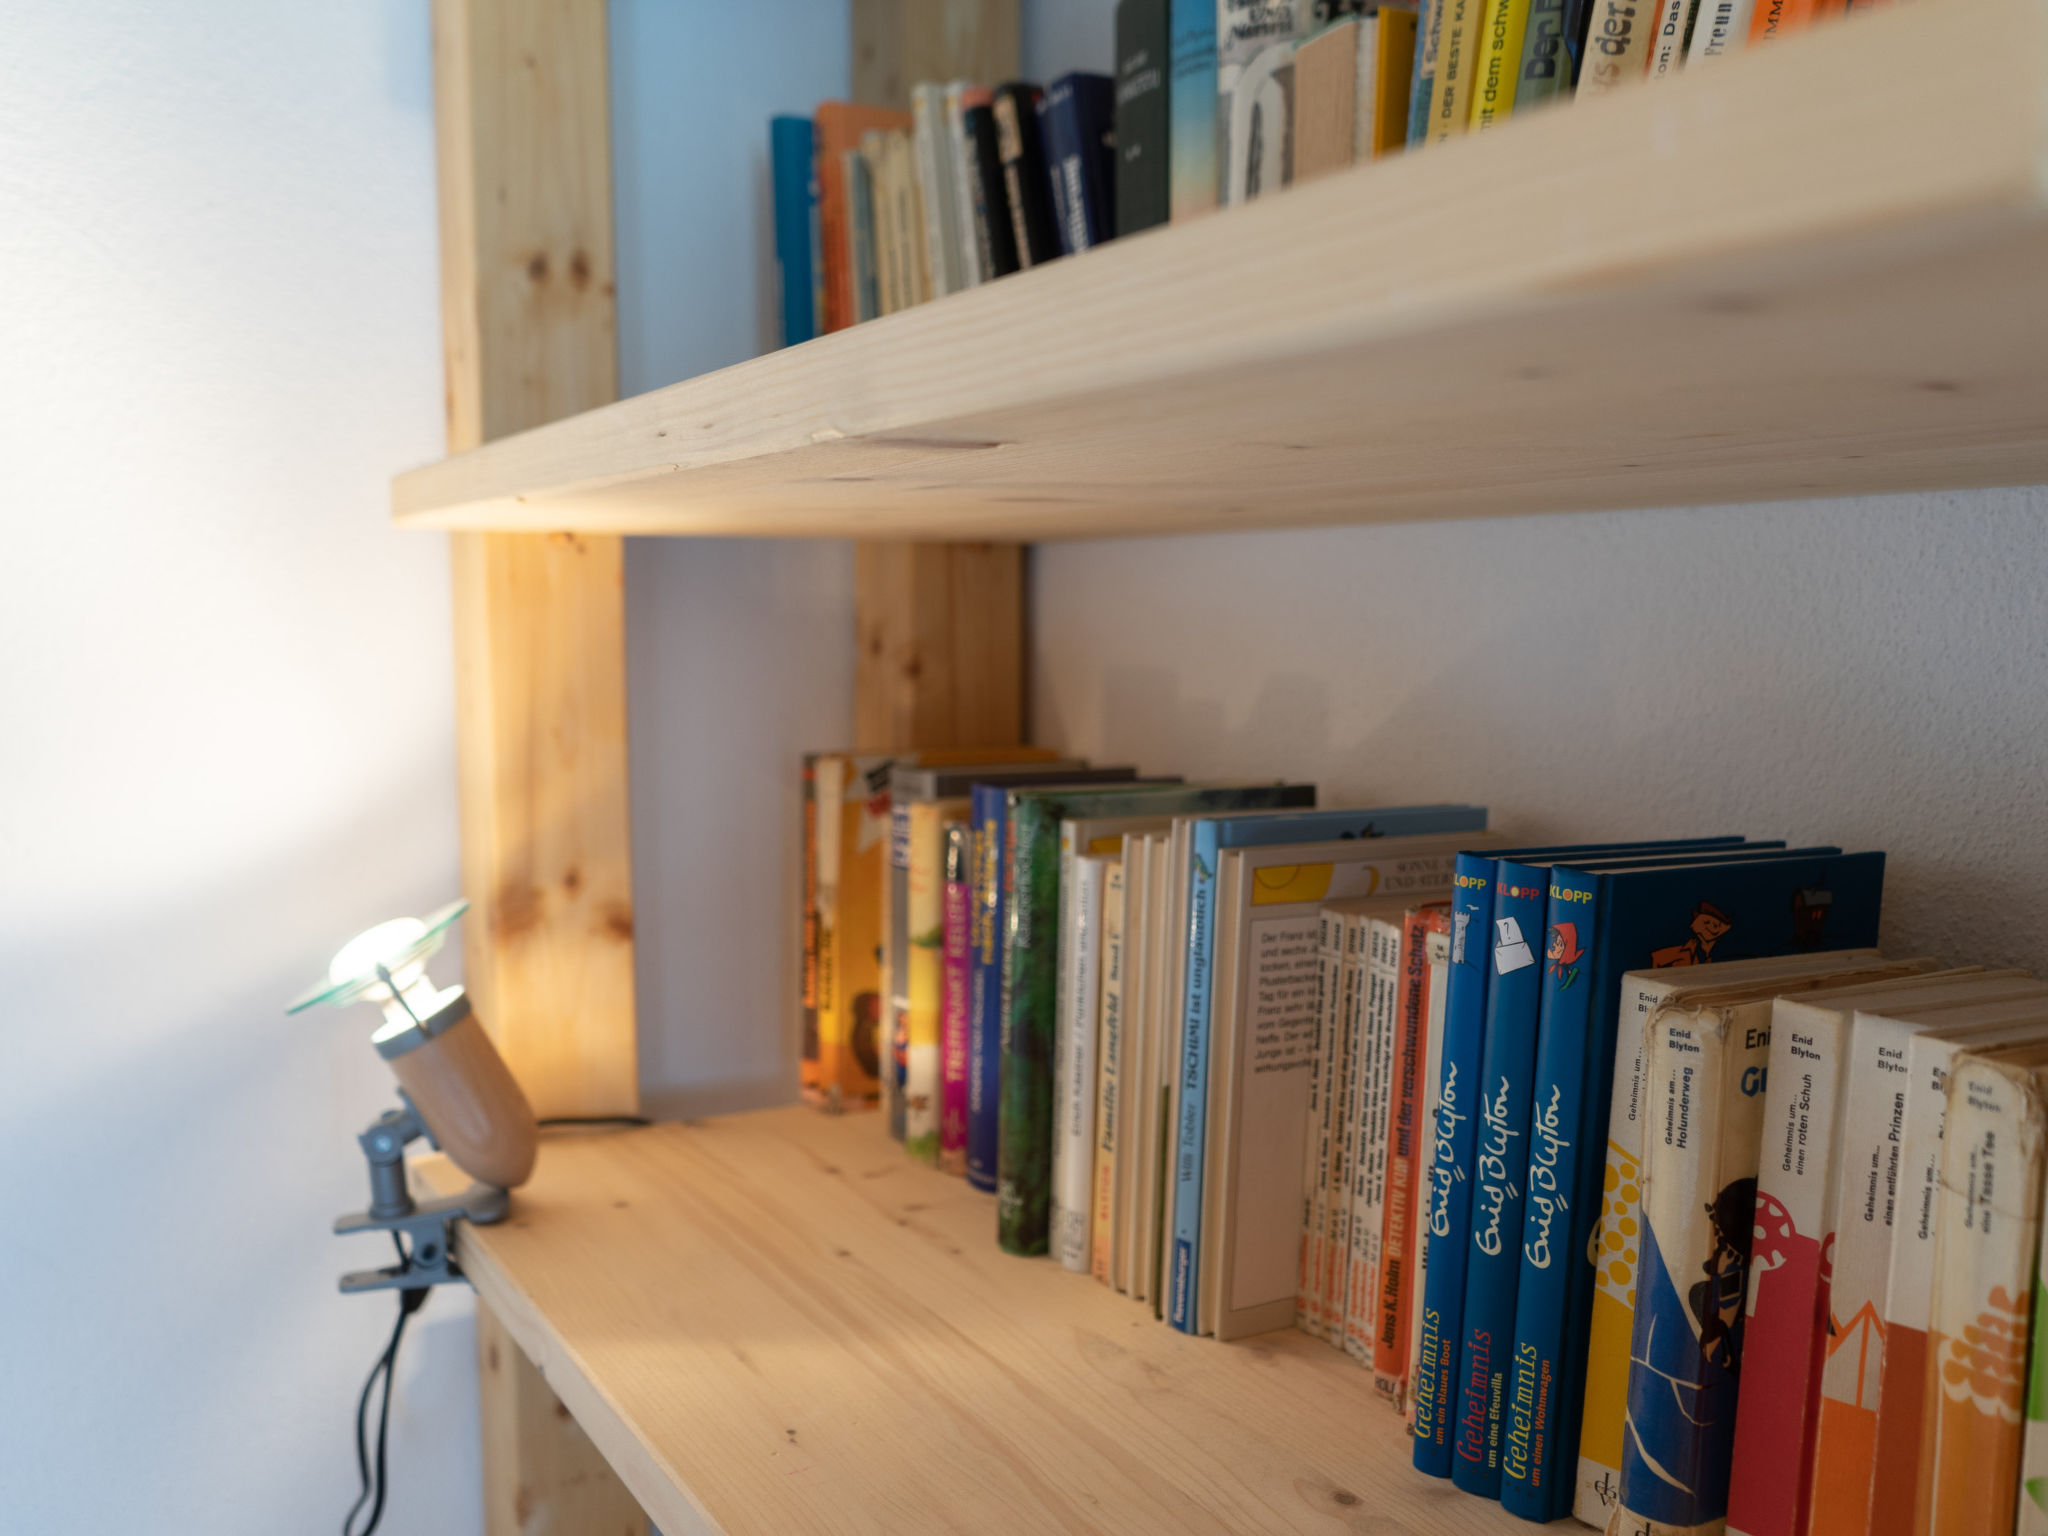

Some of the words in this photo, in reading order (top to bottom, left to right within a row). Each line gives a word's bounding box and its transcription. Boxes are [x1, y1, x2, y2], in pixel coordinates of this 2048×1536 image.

[1595, 2, 1636, 56] der
[1663, 0, 1680, 36] Das
[1447, 27, 1462, 80] BESTE
[1483, 57, 1502, 102] dem
[1441, 86, 1455, 119] DER
[1496, 882, 1540, 901] KLOPP
[1549, 884, 1593, 905] KLOPP
[1408, 924, 1424, 977] Schatz
[1639, 992, 1658, 1003] Enid
[1401, 979, 1422, 1098] verschwundene
[1669, 1027, 1691, 1039] Enid
[1669, 1040, 1699, 1053] Blyton
[1791, 1033, 1813, 1046] Enid
[1790, 1046, 1821, 1061] Blyton
[1878, 1047, 1902, 1059] Enid
[1628, 1075, 1640, 1121] Geheimnis
[1799, 1074, 1812, 1111] Schuh
[1968, 1081, 1992, 1095] Enid
[1968, 1096, 2001, 1112] Blyton
[1397, 1101, 1413, 1126] der
[1435, 1061, 1467, 1163] Blyton
[1665, 1098, 1675, 1145] Geheimnis
[1676, 1067, 1693, 1149] Holunderweg
[1888, 1093, 1904, 1142] Prinzen
[1396, 1127, 1411, 1156] und
[1479, 1076, 1520, 1180] Blyton
[1530, 1084, 1571, 1191] Blyton
[1782, 1122, 1795, 1171] Geheimnis
[1797, 1115, 1808, 1146] roten
[1981, 1131, 1995, 1157] Tee
[1393, 1157, 1408, 1188] KIM
[1796, 1149, 1805, 1175] einen
[1886, 1146, 1899, 1196] entführten
[1430, 1167, 1452, 1237] Enid
[1864, 1171, 1878, 1222] Geheimnis
[1963, 1172, 1976, 1229] Geheimnis
[1979, 1162, 1994, 1205] Tasse
[1389, 1189, 1407, 1257] DETEKTIV
[1475, 1185, 1504, 1255] Enid
[1884, 1199, 1894, 1226] einen
[1917, 1187, 1932, 1240] Geheimnis
[1525, 1196, 1554, 1269] Enid
[1173, 1246, 1189, 1323] Ravensburger
[1381, 1314, 1397, 1349] Jens
[1440, 1339, 1451, 1366] Boot
[1414, 1307, 1440, 1439] Geheimnis
[1437, 1369, 1449, 1404] blaues
[1456, 1328, 1491, 1462] Geheimnis
[1489, 1372, 1503, 1420] Efeuvilla
[1503, 1342, 1537, 1480] Geheimnis
[1534, 1360, 1552, 1430] Wohnwagen
[1436, 1407, 1447, 1424] ein
[1436, 1427, 1445, 1445] um
[1487, 1424, 1499, 1447] eine
[1531, 1434, 1544, 1465] einen
[1487, 1449, 1497, 1468] um
[1531, 1468, 1541, 1486] um
